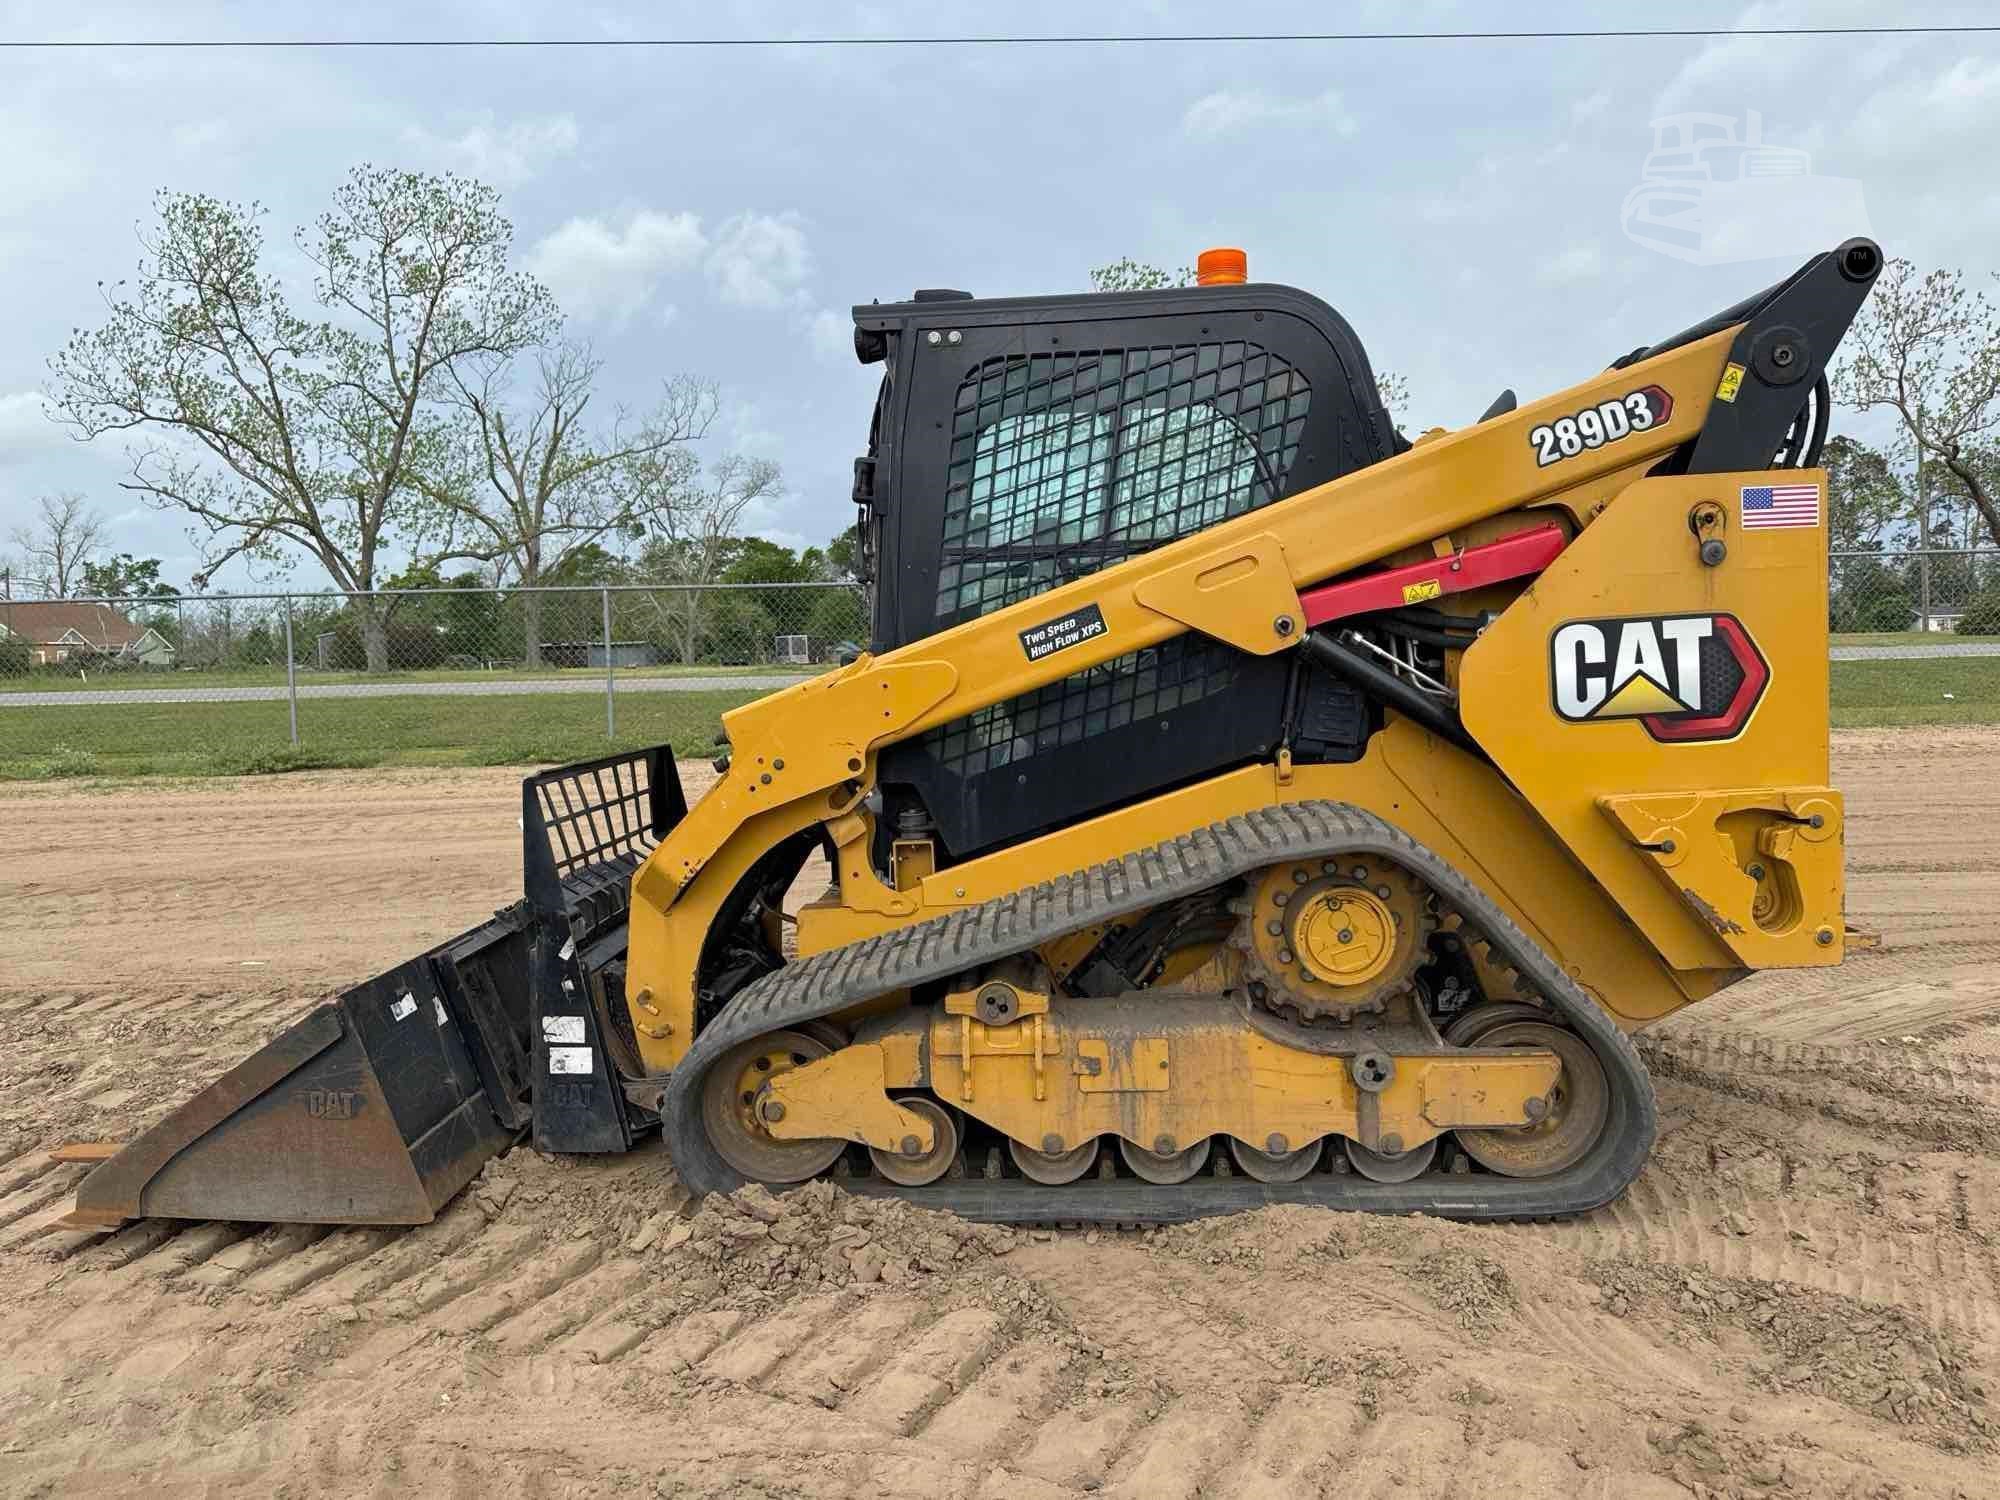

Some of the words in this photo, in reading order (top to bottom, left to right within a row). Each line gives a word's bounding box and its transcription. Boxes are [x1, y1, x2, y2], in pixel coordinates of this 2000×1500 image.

[1531, 392, 1653, 466] 289D3
[1024, 631, 1046, 646] TWO
[1047, 618, 1076, 637] SPEED
[1030, 641, 1054, 659] HIGH
[1055, 631, 1079, 649] FLOW
[1081, 621, 1102, 638] XPS
[1554, 617, 1712, 718] CAT
[307, 1089, 353, 1117] CAT
